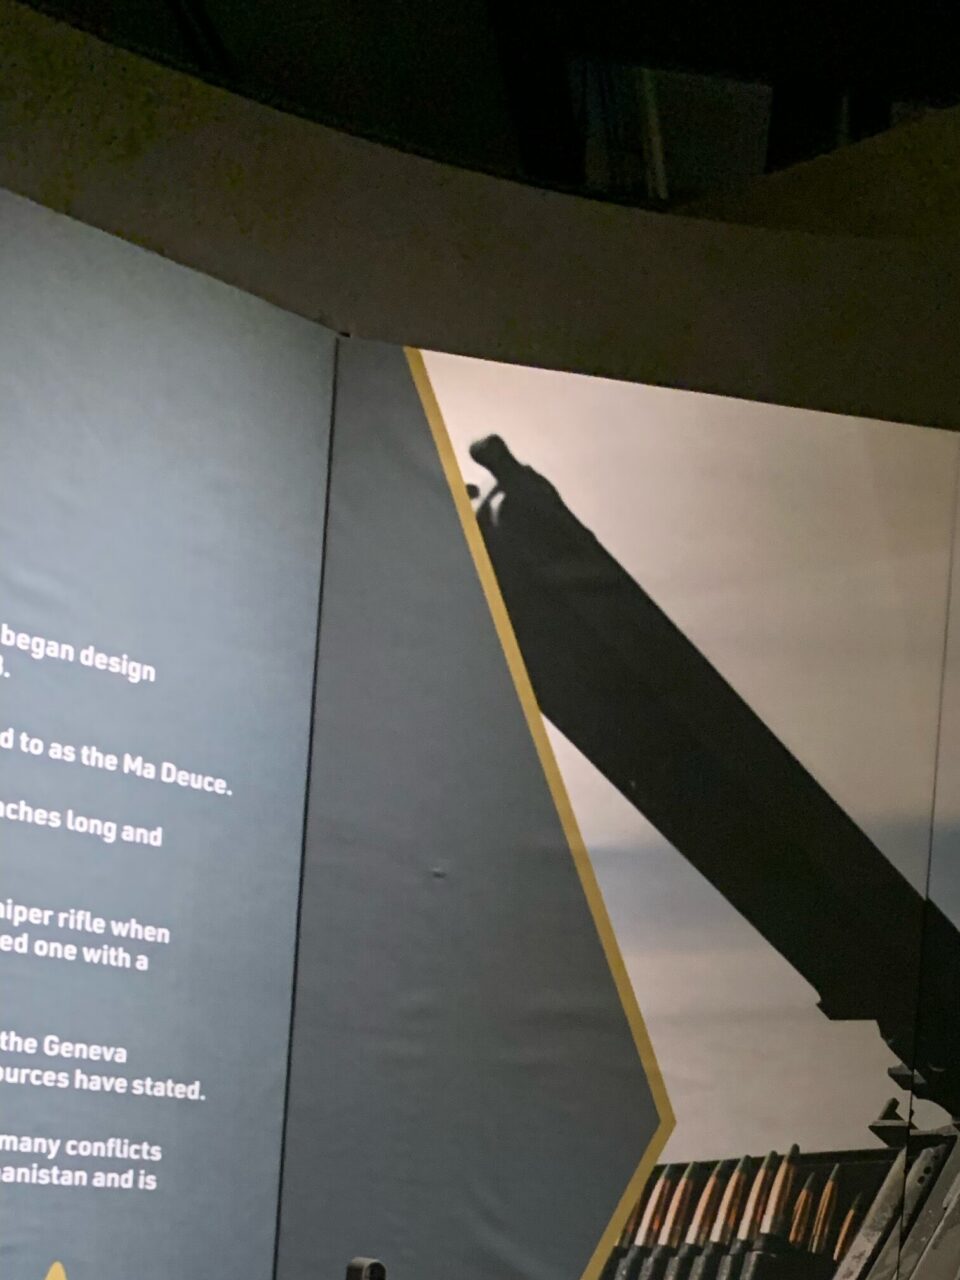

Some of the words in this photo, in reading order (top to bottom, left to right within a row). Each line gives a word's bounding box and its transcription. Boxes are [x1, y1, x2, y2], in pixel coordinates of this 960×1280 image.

[1, 623, 74, 661] began
[80, 646, 155, 683] design
[20, 731, 43, 755] to
[48, 742, 76, 762] as
[81, 746, 118, 771] the
[123, 753, 155, 779] Ma
[161, 762, 233, 796] Deuce.
[66, 809, 117, 843] long
[121, 827, 163, 847] and
[58, 908, 105, 934] rifle
[111, 918, 170, 944] when
[34, 939, 77, 961] one
[82, 944, 131, 968] with
[136, 954, 149, 971] a
[0, 1030, 38, 1054] the
[43, 1034, 128, 1063] Geneva
[74, 1069, 128, 1093] have
[131, 1076, 206, 1101] stated.
[0, 1134, 60, 1160] many
[65, 1137, 162, 1161] conflicts
[92, 1169, 134, 1189] and
[138, 1170, 157, 1191] is
